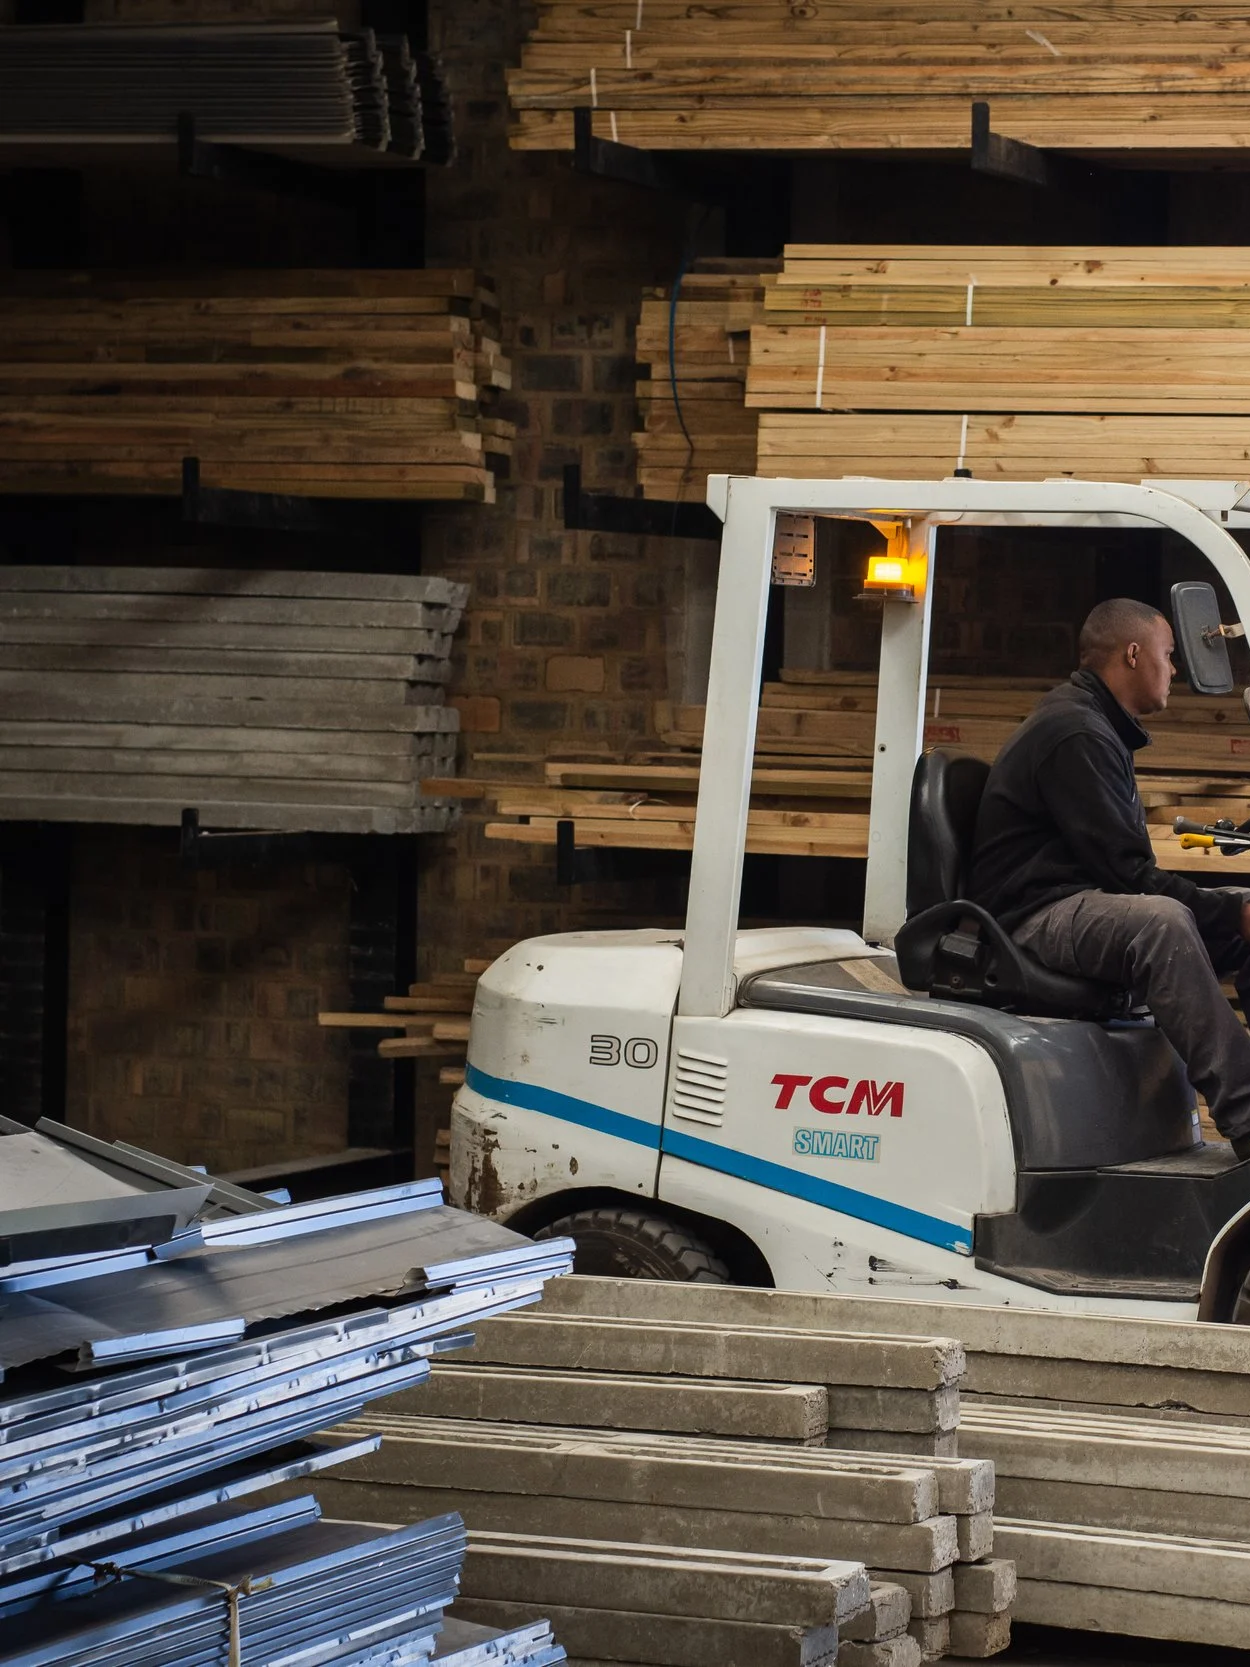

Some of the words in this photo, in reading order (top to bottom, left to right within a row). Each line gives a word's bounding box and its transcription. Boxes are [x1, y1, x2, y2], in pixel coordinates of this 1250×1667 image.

[589, 1034, 658, 1069] 30
[770, 1073, 905, 1118] TCM
[794, 1129, 880, 1161] SMART
